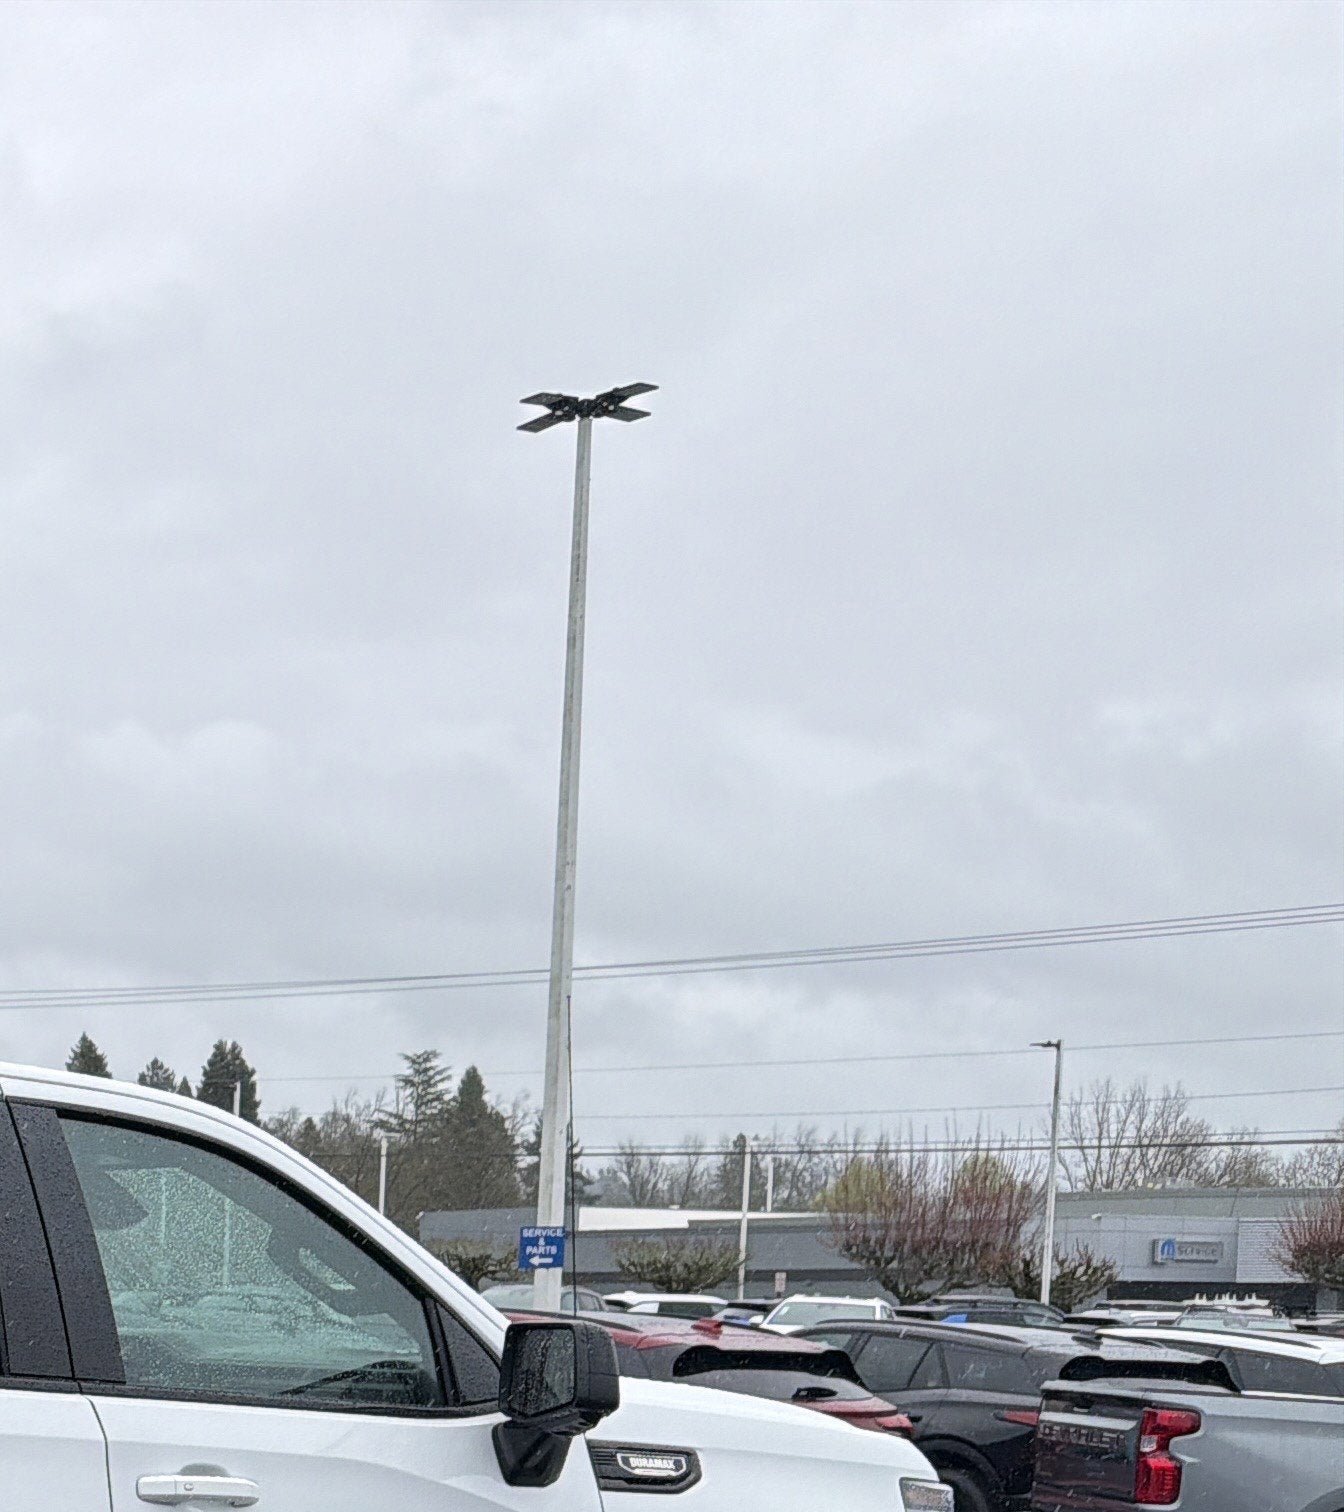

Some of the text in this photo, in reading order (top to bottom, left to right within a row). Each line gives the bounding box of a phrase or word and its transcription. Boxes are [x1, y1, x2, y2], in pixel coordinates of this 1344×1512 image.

[522, 1228, 564, 1238] SERVICE
[525, 1245, 558, 1255] PARTS
[629, 1456, 676, 1470] DURAMAX
